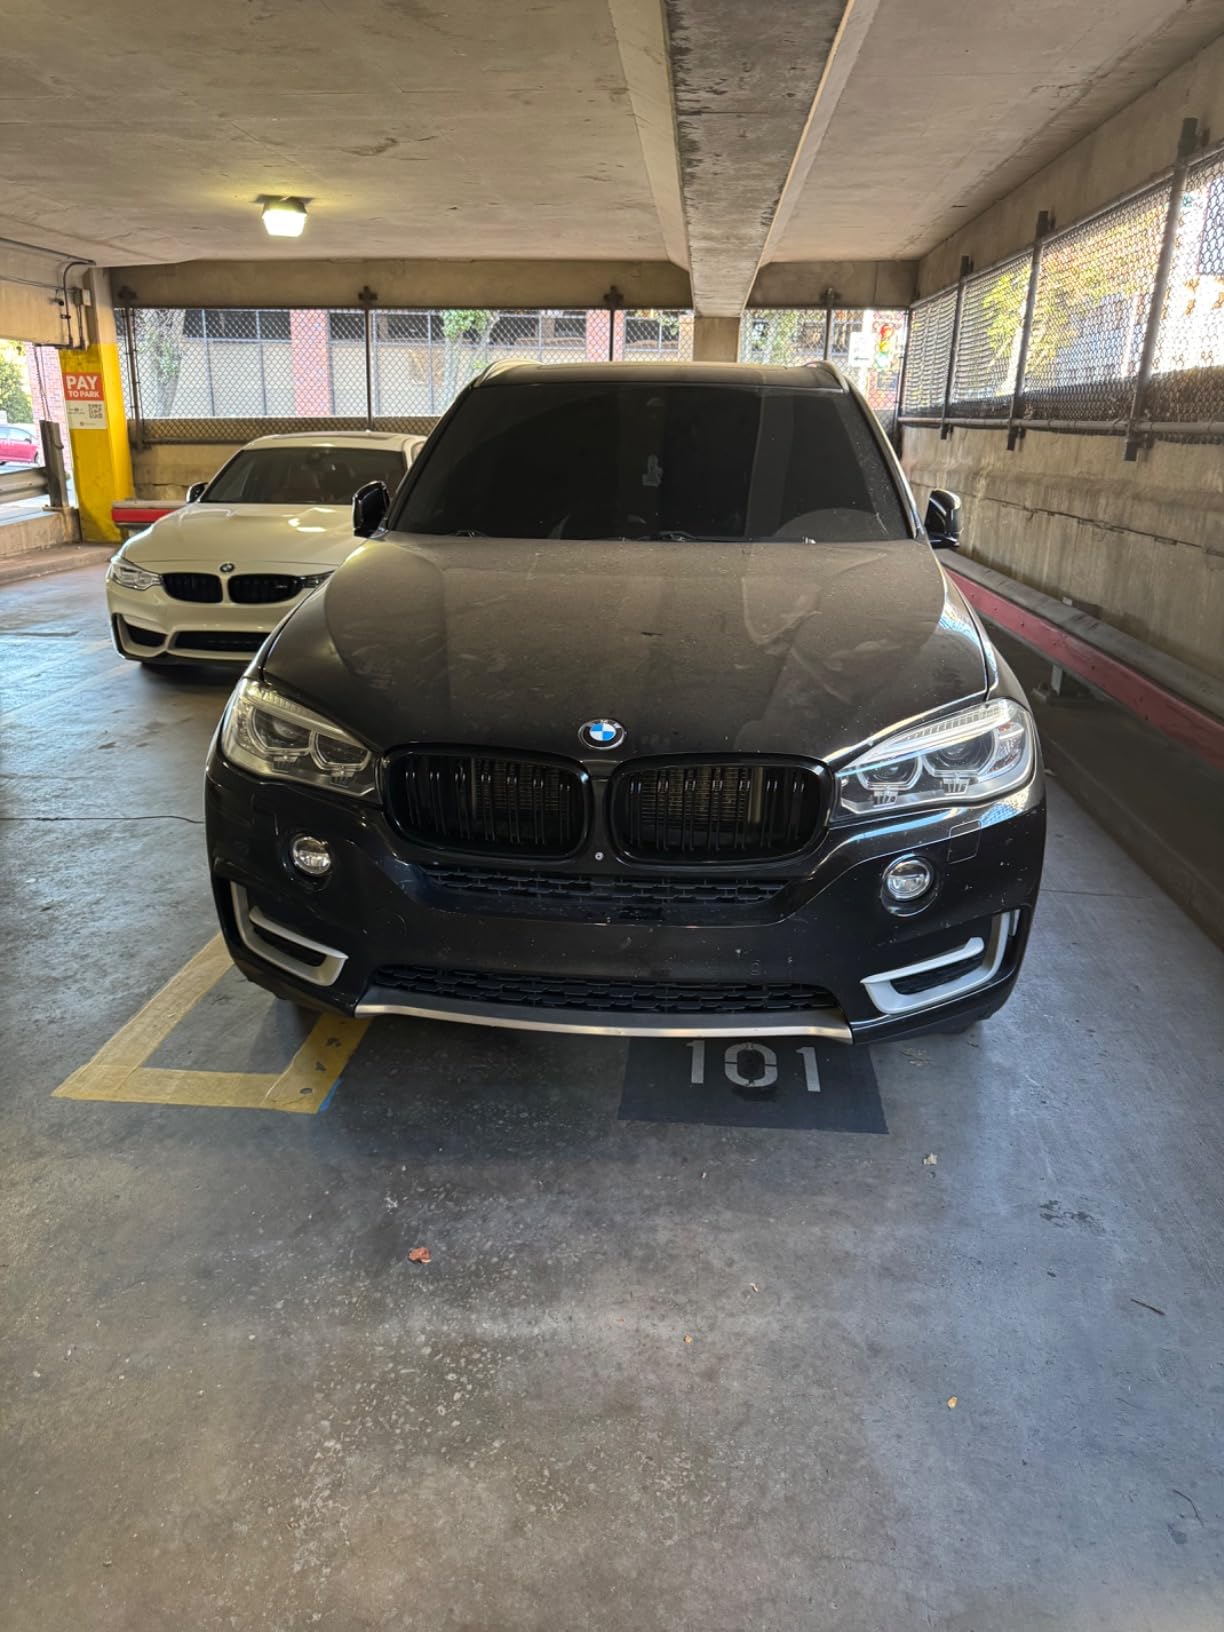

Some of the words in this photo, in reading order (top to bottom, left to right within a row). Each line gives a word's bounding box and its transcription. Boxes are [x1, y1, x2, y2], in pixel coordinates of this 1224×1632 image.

[66, 375, 97, 390] PAY
[68, 390, 79, 398] TO
[80, 390, 100, 398] PARK
[685, 1039, 821, 1093] 101
